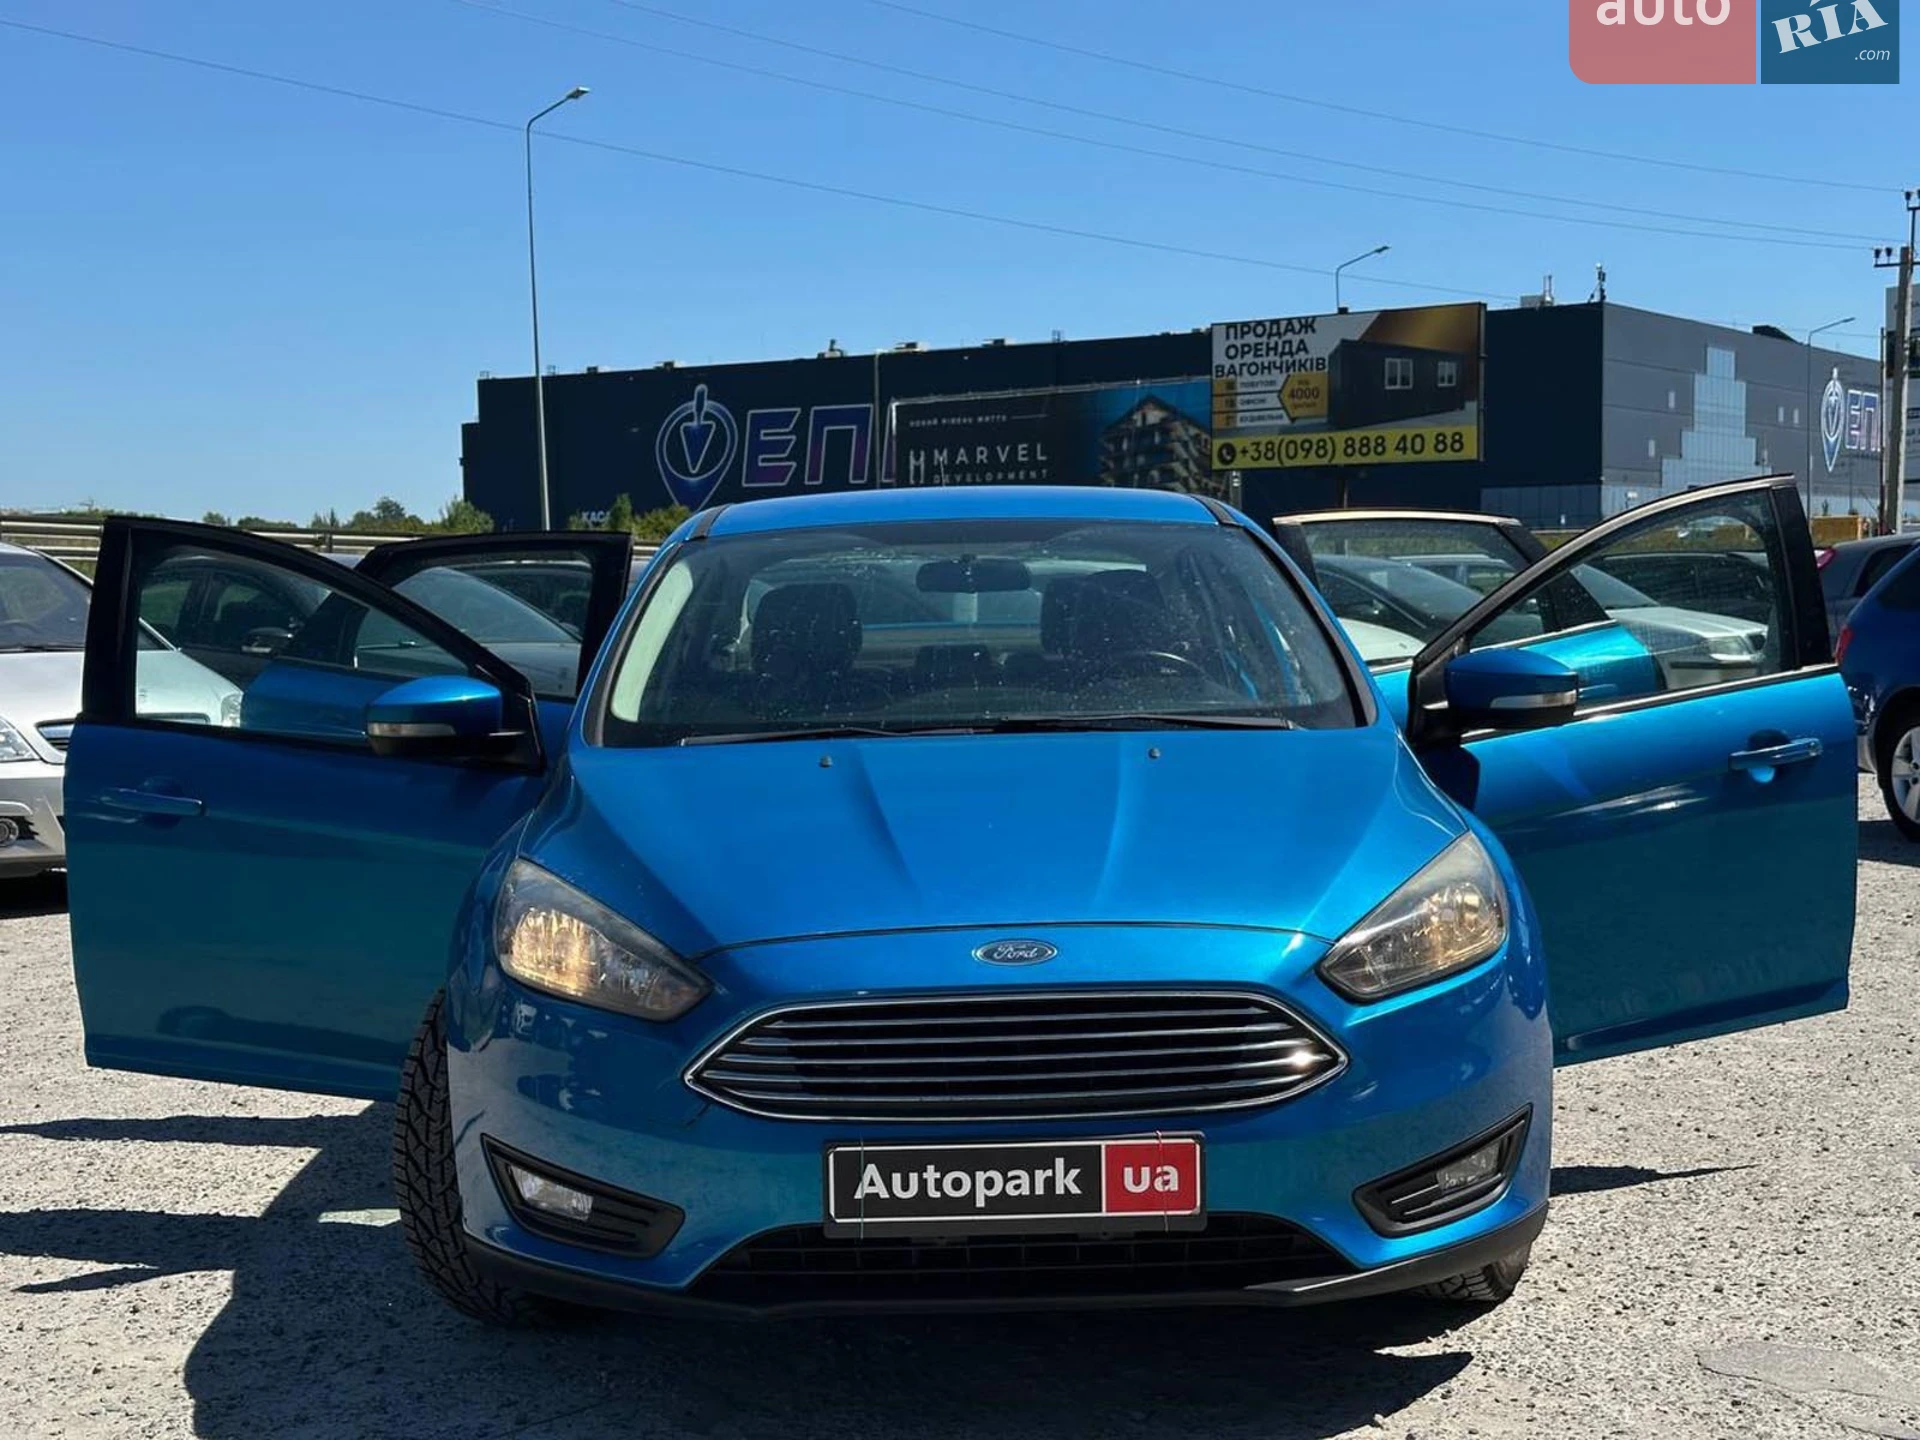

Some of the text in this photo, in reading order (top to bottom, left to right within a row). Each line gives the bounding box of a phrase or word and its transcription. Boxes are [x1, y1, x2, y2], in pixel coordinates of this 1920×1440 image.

[1225, 318, 1316, 340] ПРОДАЖ
[1225, 339, 1308, 360] ОРЕНДА
[1215, 358, 1326, 378] ВАГОНЧИКІВ
[1288, 386, 1320, 400] 4000
[933, 443, 1048, 466] MARVEL
[1240, 432, 1464, 465] +38(098) 888 40 88
[994, 945, 1037, 959] Ford
[854, 1157, 1178, 1207] Autopark ua
